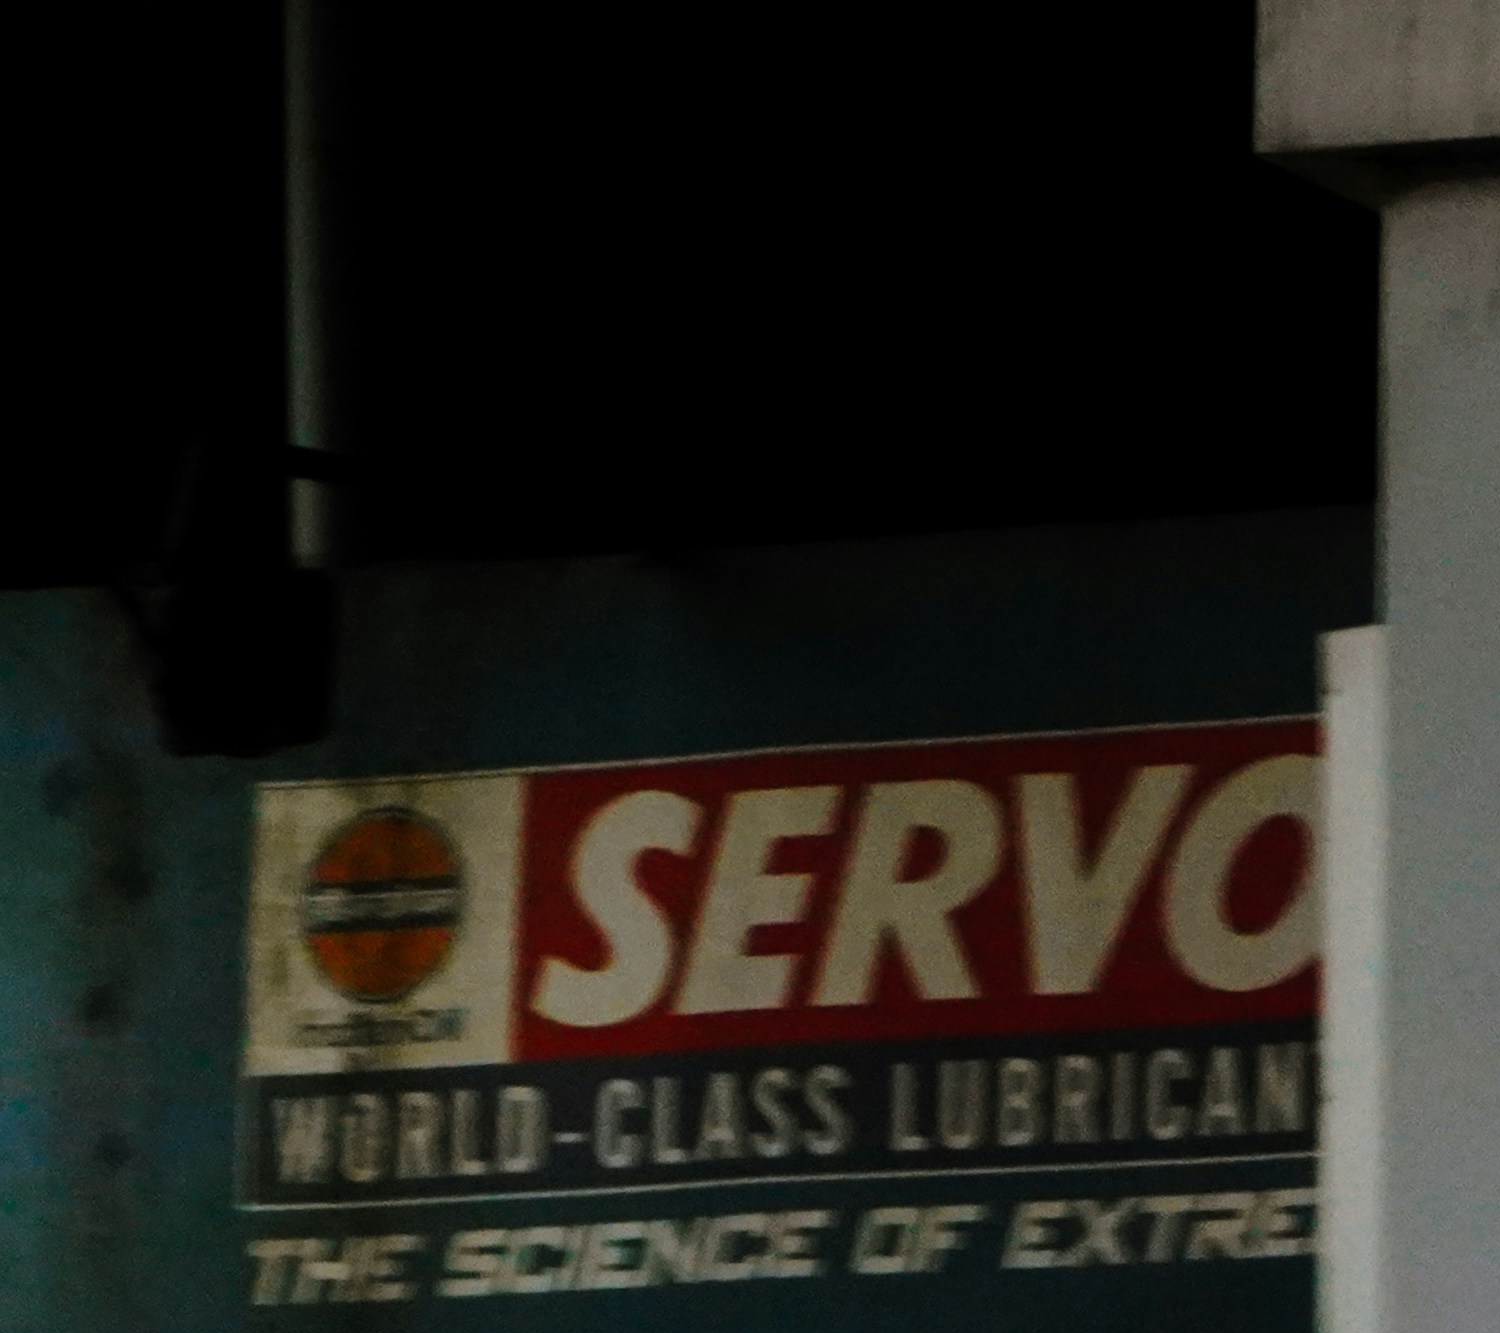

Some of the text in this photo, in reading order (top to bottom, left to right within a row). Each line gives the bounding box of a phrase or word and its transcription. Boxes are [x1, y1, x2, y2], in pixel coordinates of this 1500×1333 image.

[528, 752, 1320, 1028] SERVO
[272, 1064, 854, 1185] WORLD-CLASS
[247, 1187, 1318, 1306] THE SCIENCE OF EXTRE
